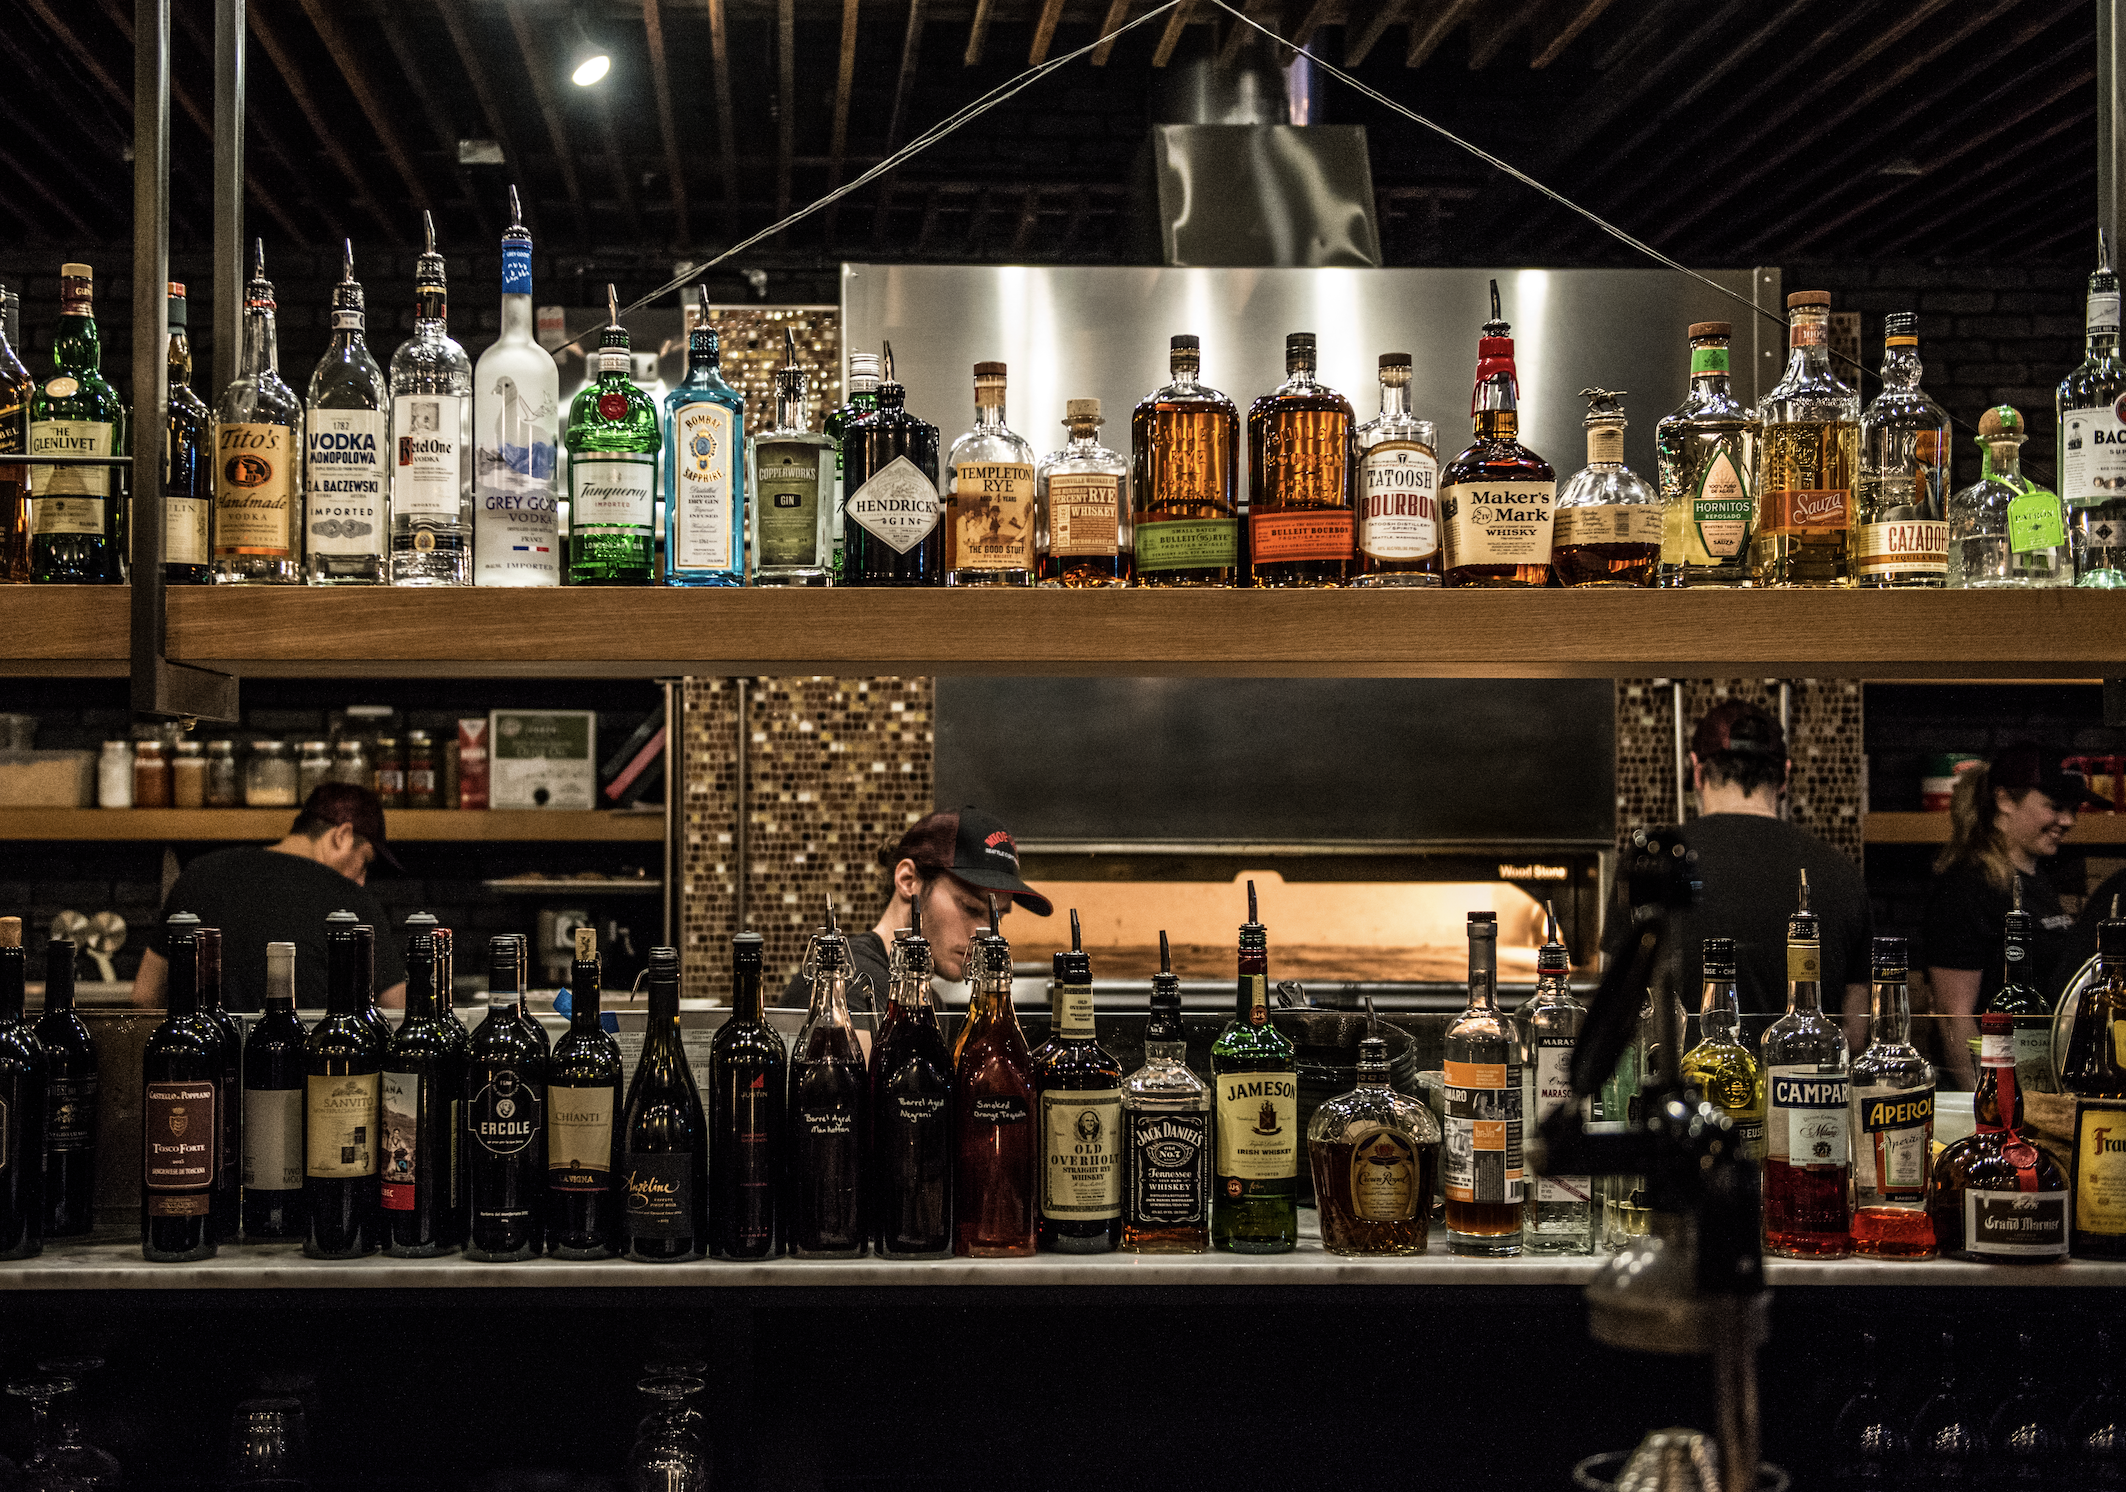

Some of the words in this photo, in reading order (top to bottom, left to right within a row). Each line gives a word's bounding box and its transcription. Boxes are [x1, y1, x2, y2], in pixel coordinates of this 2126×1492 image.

[333, 421, 350, 431] 1782
[684, 414, 723, 431] BOMBAY
[50, 427, 71, 437] THE
[221, 428, 281, 450] Tito's
[33, 437, 96, 452] GLENLIVET
[309, 432, 377, 451] VODKA
[430, 439, 452, 454] One
[309, 451, 377, 465] MONOPOLOWA
[682, 466, 726, 484] SAPPHIRE
[759, 467, 816, 481] COPPERWORKS
[960, 466, 1031, 481] TEMPLETON
[1367, 469, 1432, 489] TATOOSH
[323, 480, 379, 493] BACZEWSKI
[580, 482, 648, 502] Tanqueray
[983, 479, 1014, 493] RYE
[780, 495, 795, 506] GIN
[1052, 494, 1088, 504] PERCENT
[1088, 487, 1116, 504] RYE
[1470, 490, 1550, 505] Maker's
[485, 496, 523, 511] GREY
[856, 499, 938, 514] HENDRICK'S
[1361, 493, 1436, 522] BOURBON
[1696, 502, 1750, 513] HORNITOS
[1793, 493, 1844, 524] Sauza
[228, 513, 268, 521] VODKA
[310, 507, 374, 516] IMPORTED
[1070, 506, 1116, 518] WHISKEY
[1494, 507, 1549, 522] Mark
[508, 513, 553, 525] VODKA
[1160, 535, 1195, 543] BULLEIT
[1271, 528, 1308, 536] BULLEIT
[968, 545, 982, 553] THE
[984, 545, 1003, 554] GOOD
[1006, 545, 1025, 554] STUFF
[1890, 554, 1926, 562] TEQUILA
[506, 562, 554, 571] IMPORTED
[1500, 865, 1532, 879] Wood
[1533, 866, 1567, 879] Stone
[1227, 1081, 1296, 1101] JAMESON
[324, 1097, 374, 1108] SANVITO
[898, 1097, 925, 1107] Barrel
[556, 1112, 599, 1122] CHIANTI
[804, 1113, 830, 1123] Barrel
[900, 1109, 932, 1123] Negroni
[1869, 1097, 1933, 1126] APEROL
[480, 1120, 531, 1135] ERCOLE
[1136, 1125, 1163, 1147] JACK
[1163, 1121, 1204, 1149] DANIEL'S
[1074, 1143, 1103, 1155] OLD
[1051, 1153, 1119, 1167] OVERHOLT
[1062, 1166, 1099, 1174] STRAIGHT
[1071, 1173, 1105, 1181] WHISKEY
[1148, 1167, 1192, 1178] Tennessee
[1359, 1171, 1383, 1186] Crown
[1376, 1171, 1411, 1186] Royal
[1148, 1183, 1191, 1191] WHISKEY
[1984, 1215, 2020, 1231] Grand
[2020, 1217, 2060, 1232] Marnier
